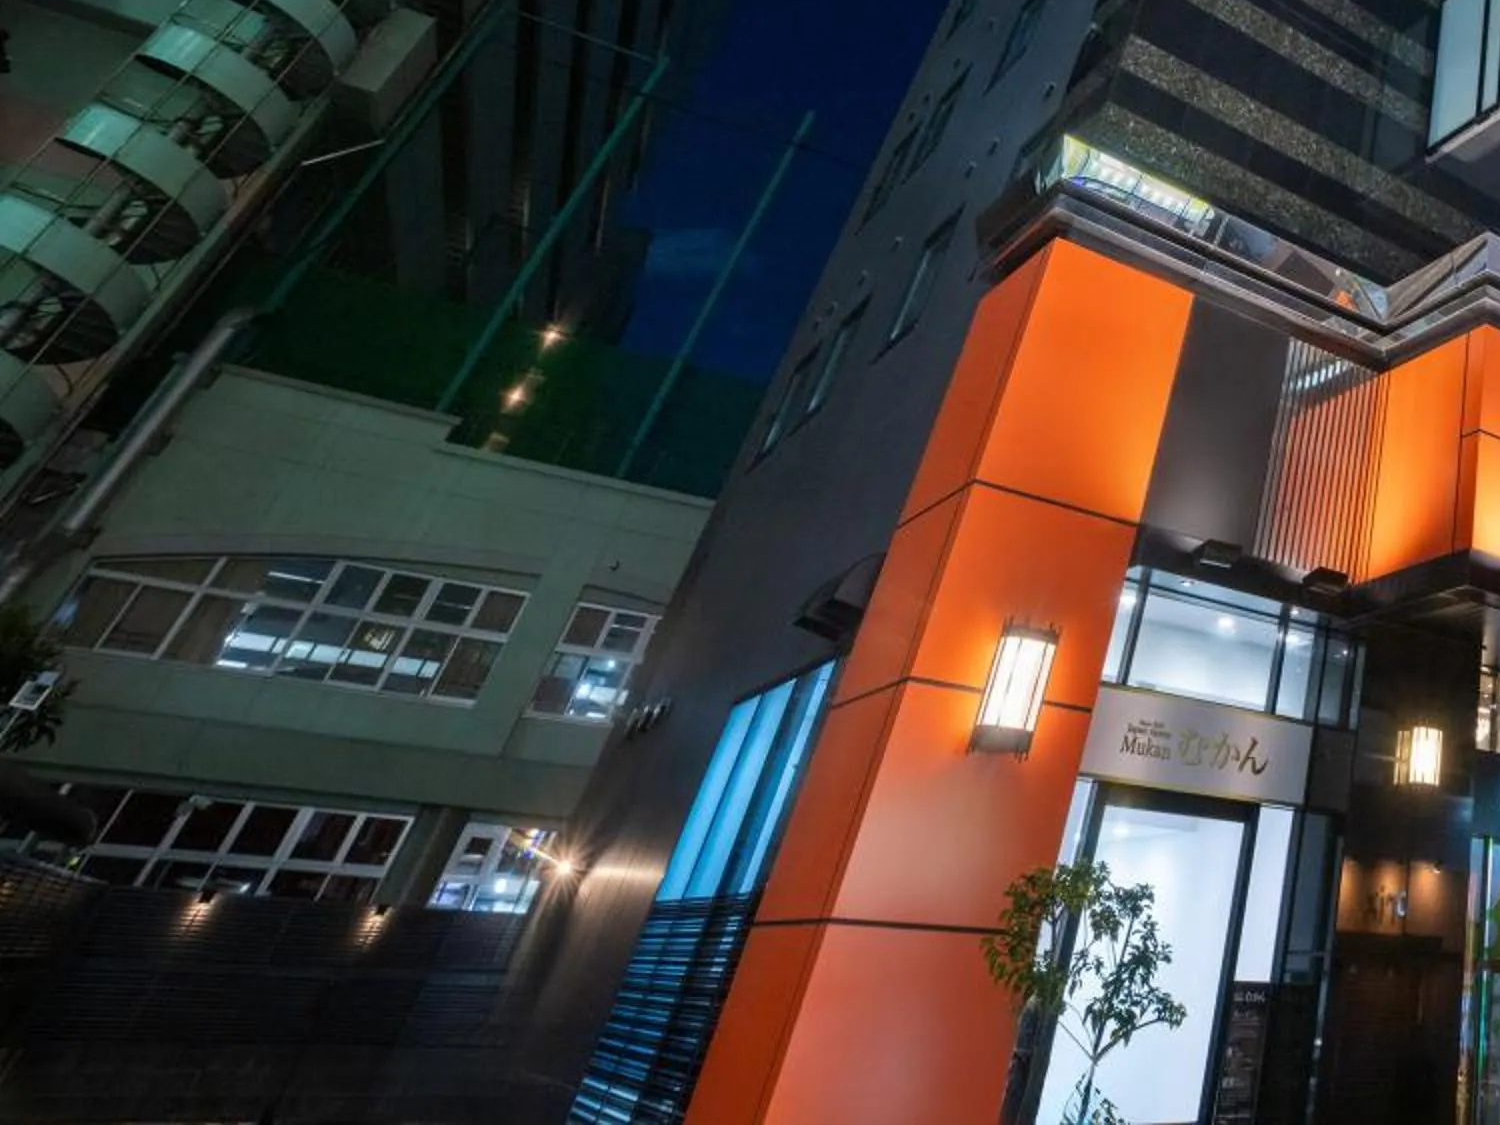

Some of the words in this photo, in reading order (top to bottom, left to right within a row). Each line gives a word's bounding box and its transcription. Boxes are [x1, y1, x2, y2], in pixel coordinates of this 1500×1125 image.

[1119, 735, 1171, 760] Mukan
[1177, 728, 1270, 776] むかん
